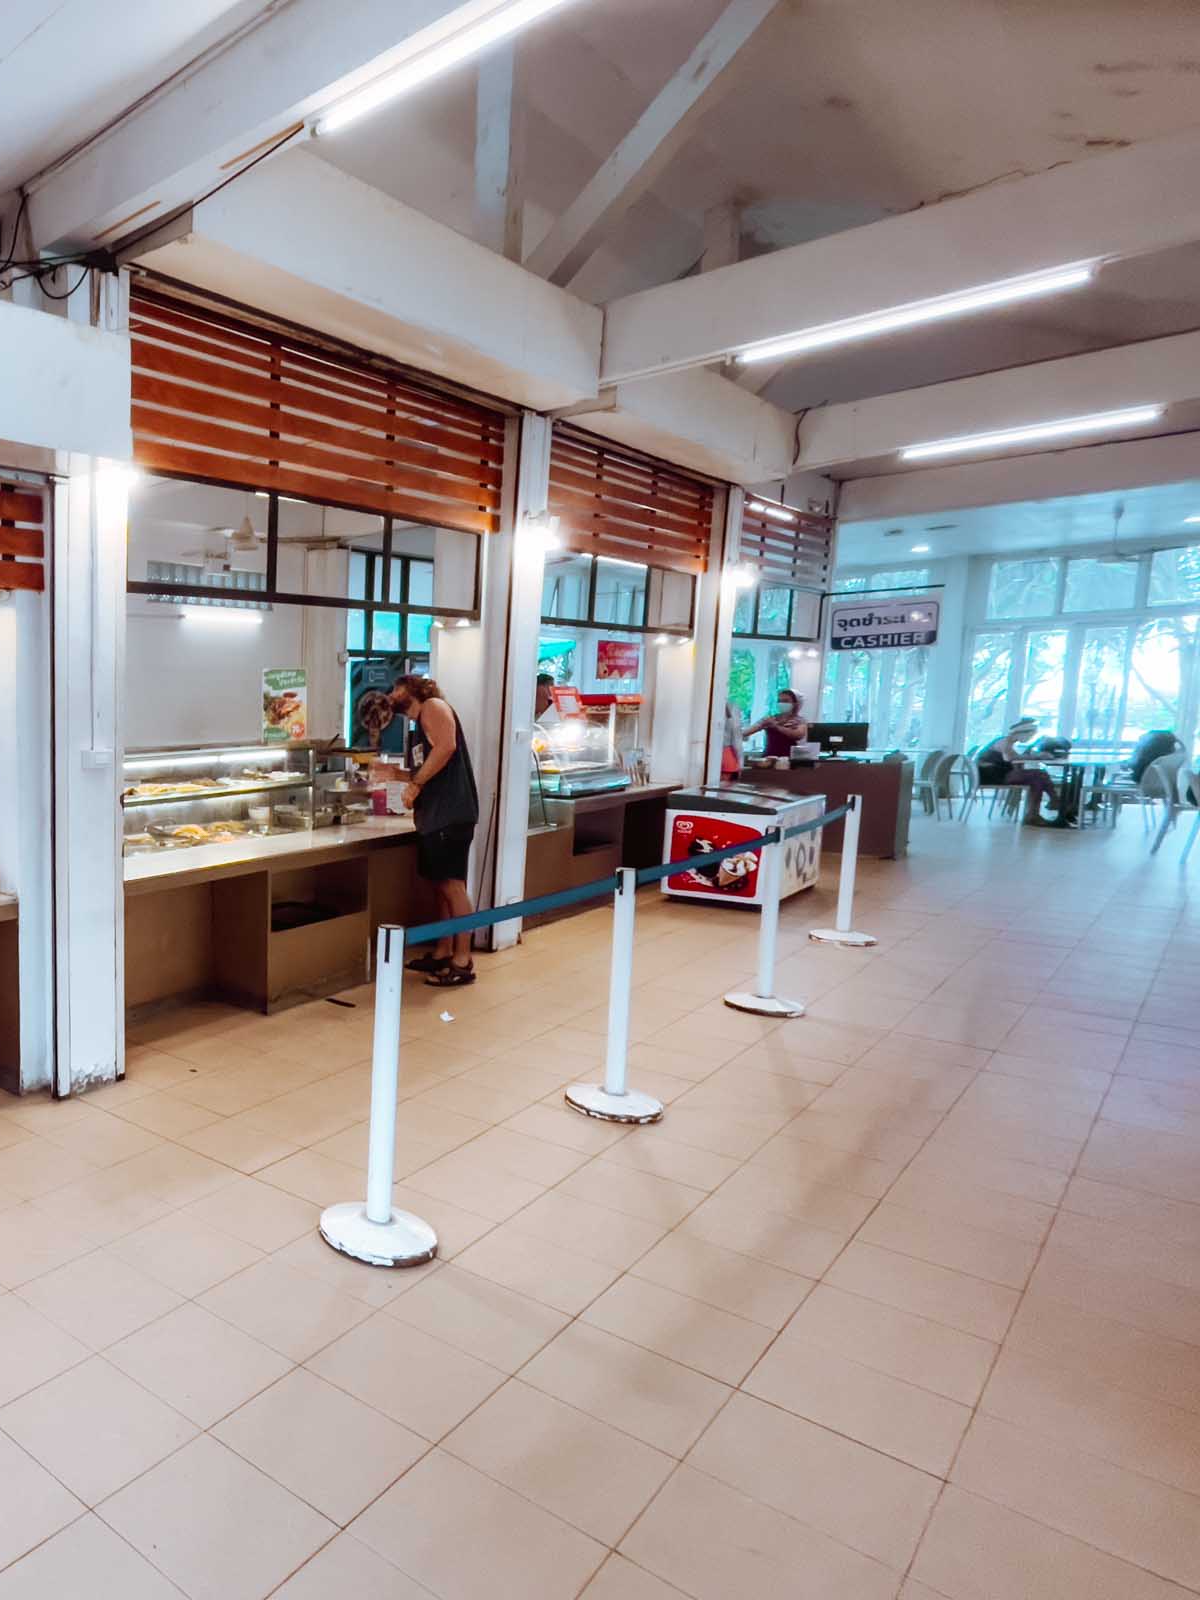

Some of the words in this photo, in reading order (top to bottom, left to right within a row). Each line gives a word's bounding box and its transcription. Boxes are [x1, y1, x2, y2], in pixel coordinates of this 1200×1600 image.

[836, 611, 933, 631] จุดชำระเ
[840, 632, 926, 649] CASHIER
